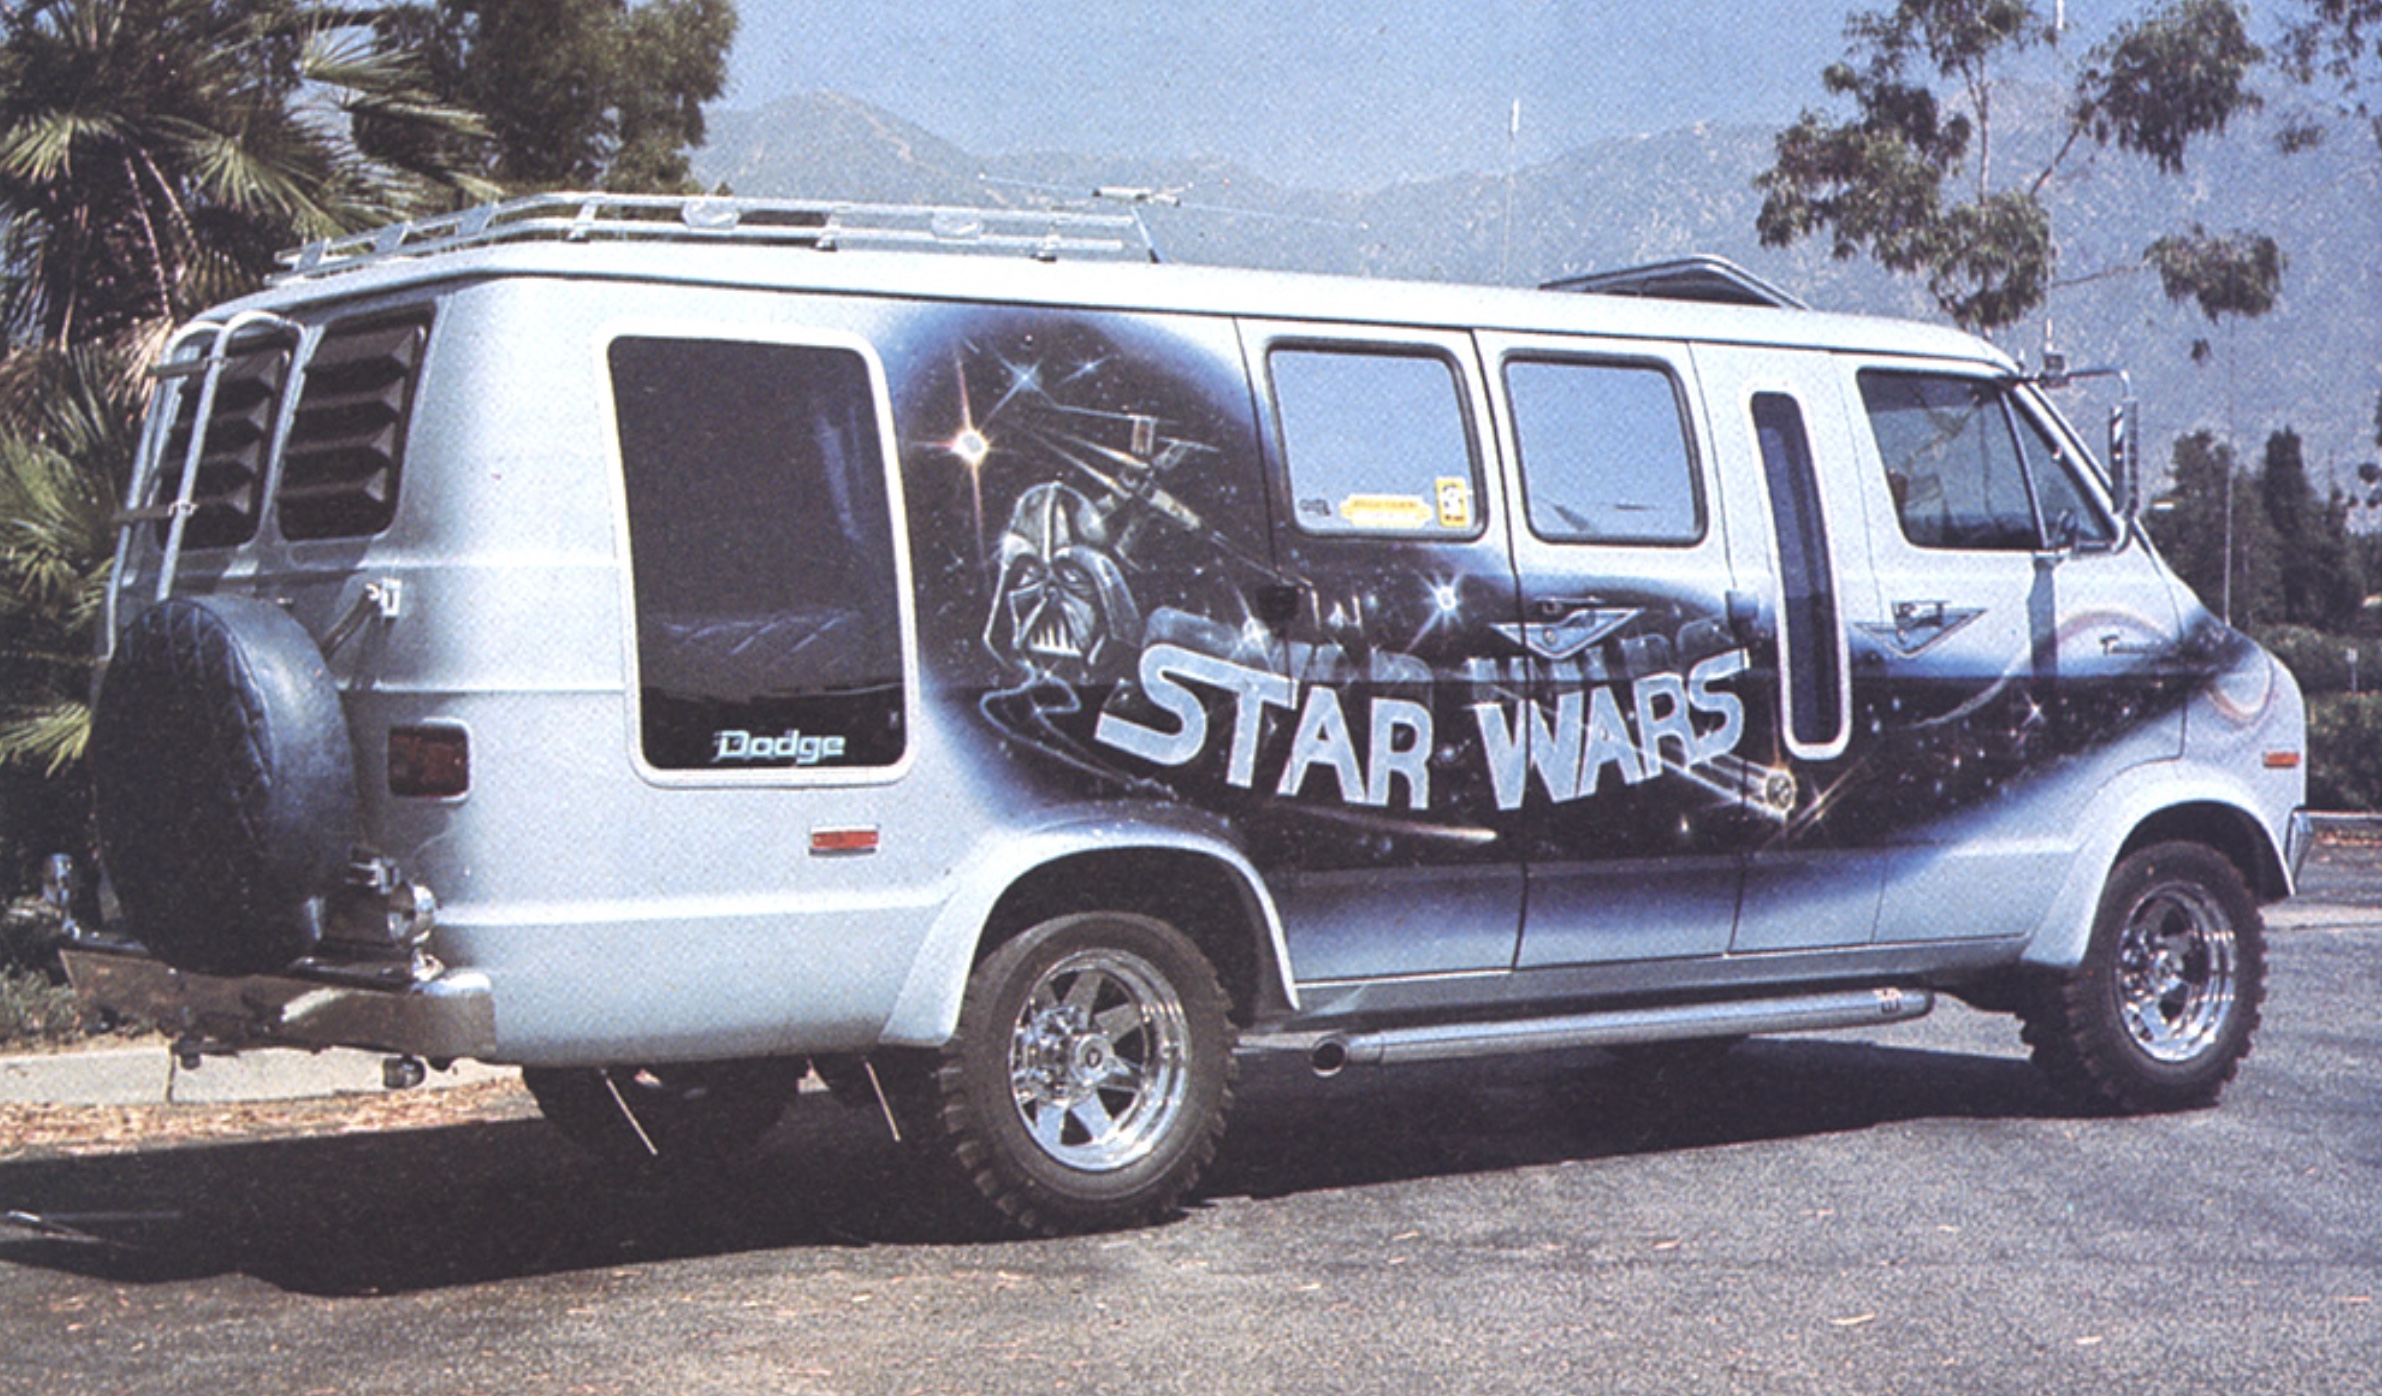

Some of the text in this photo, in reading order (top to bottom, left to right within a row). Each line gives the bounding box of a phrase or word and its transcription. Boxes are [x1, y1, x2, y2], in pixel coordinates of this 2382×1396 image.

[711, 729, 845, 764] Dodge
[1095, 644, 1751, 811] STAR WARS
